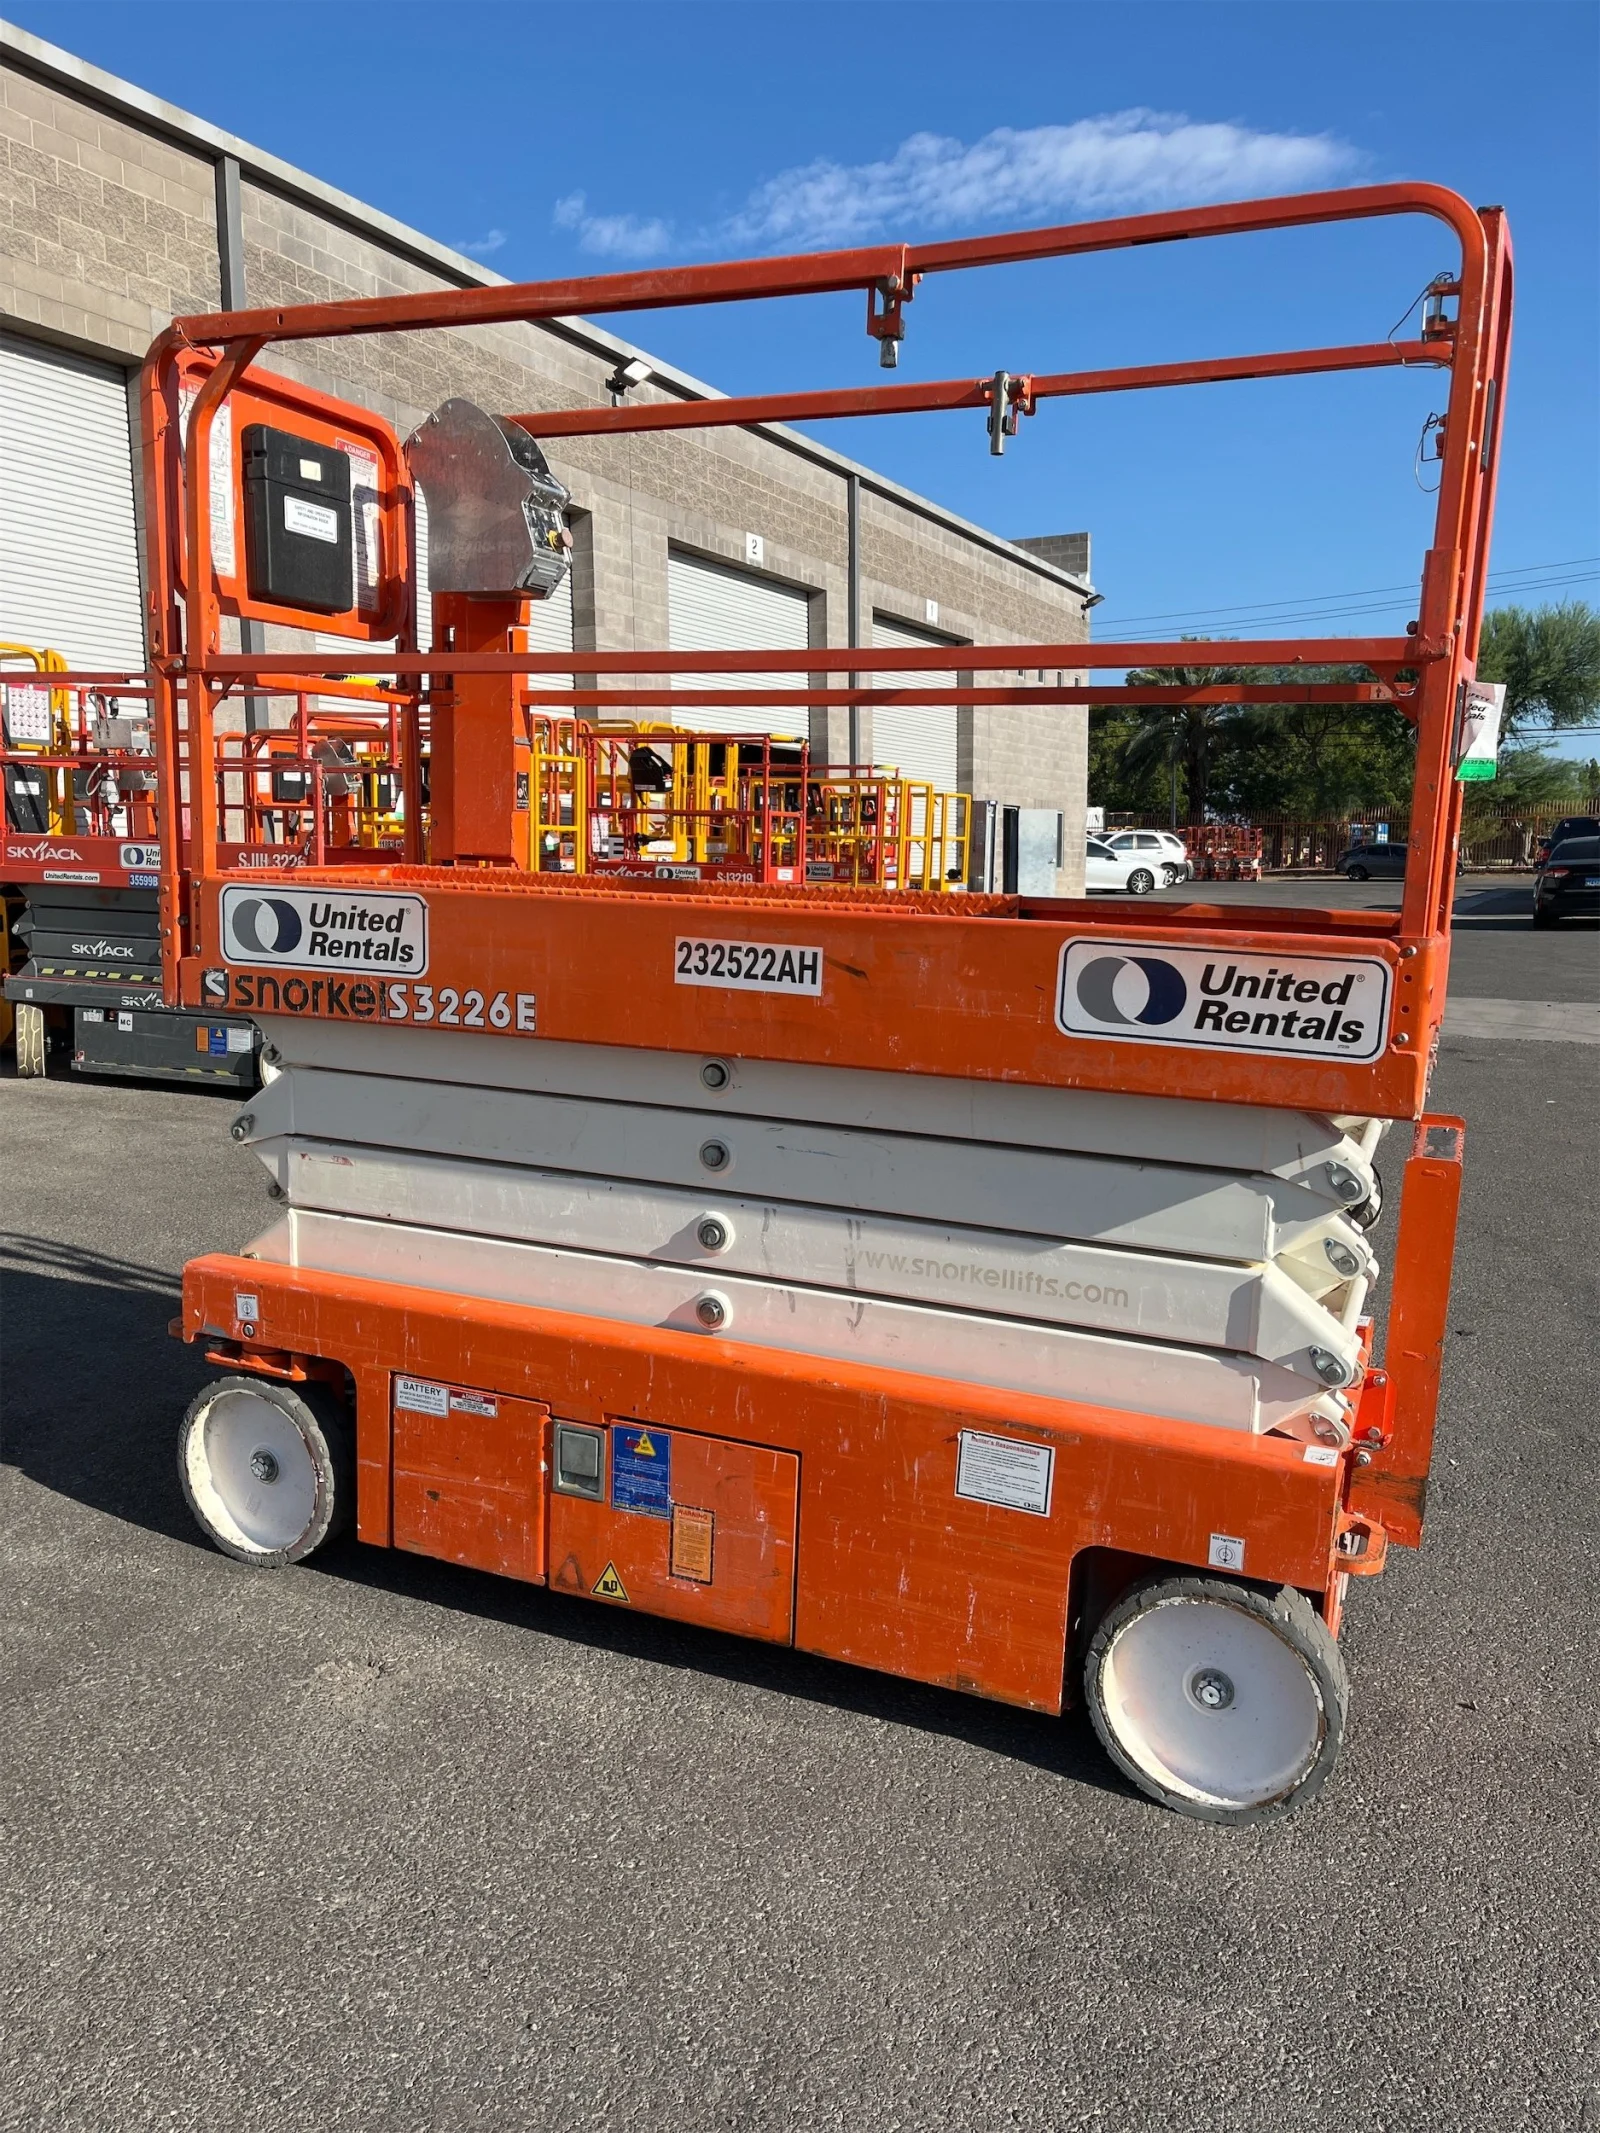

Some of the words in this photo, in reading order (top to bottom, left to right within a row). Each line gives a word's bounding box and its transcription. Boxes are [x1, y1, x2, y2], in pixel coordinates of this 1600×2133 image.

[751, 538, 758, 555] 2
[7, 841, 83, 861] SKYJACK
[272, 853, 307, 868] 3226
[45, 871, 99, 882] UnitedRentals.com
[309, 902, 405, 934] United
[71, 941, 134, 957] SKYJACK
[308, 932, 414, 964] Rentals
[677, 941, 819, 985] 232522AH
[1199, 963, 1356, 1006] United
[235, 974, 387, 1019] snorkel
[387, 984, 537, 1032] S3226E
[120, 1018, 131, 1026] MC
[1193, 998, 1365, 1044] Rentals
[403, 1381, 441, 1396] BATTERY
[677, 1508, 708, 1521] WARNING
